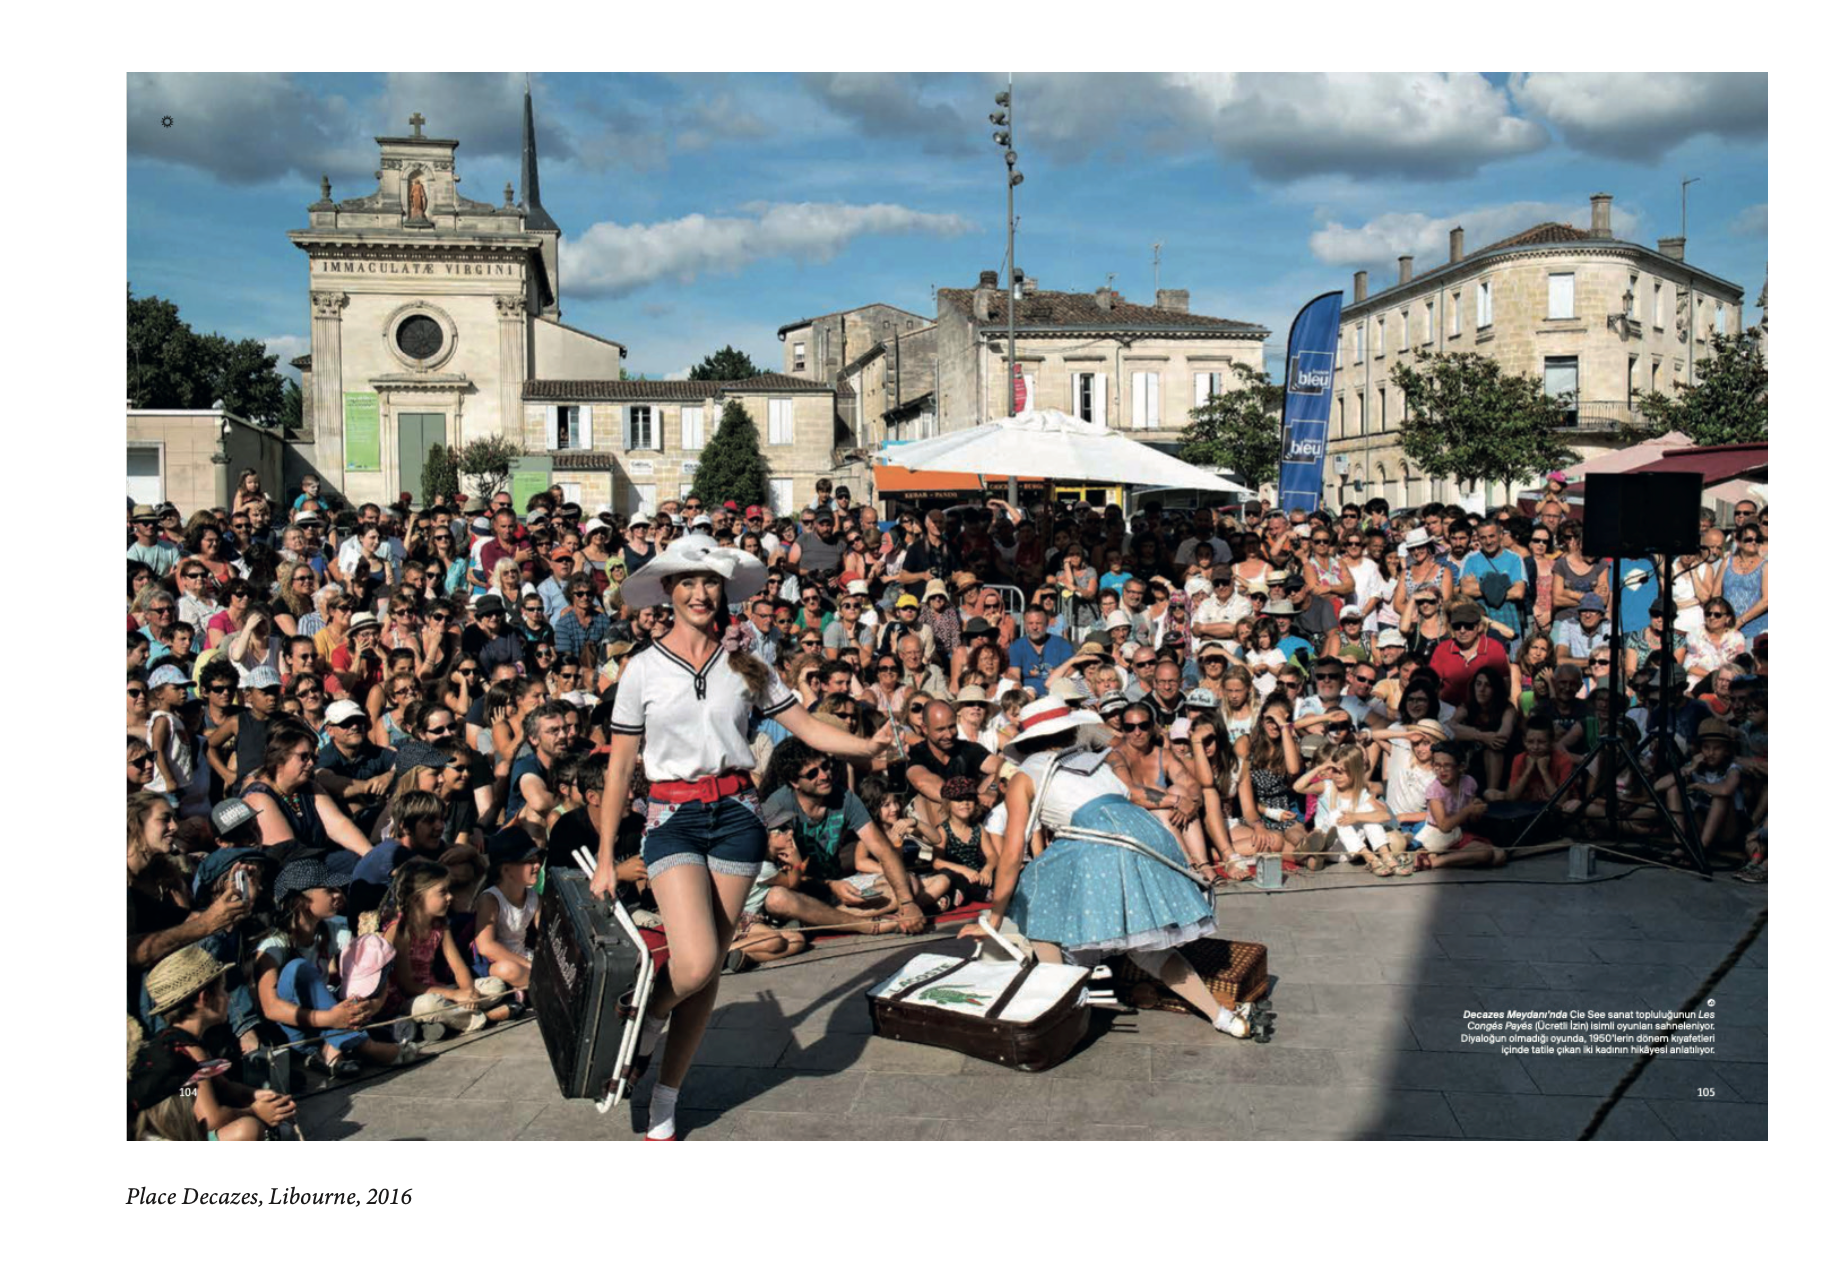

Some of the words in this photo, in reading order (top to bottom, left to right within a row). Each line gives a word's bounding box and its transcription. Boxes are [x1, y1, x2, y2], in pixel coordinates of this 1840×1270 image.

[323, 261, 434, 274] IMMACULATÆ
[445, 263, 513, 275] VIRGINI
[1298, 371, 1329, 387] bleu
[1291, 440, 1321, 455] bleu
